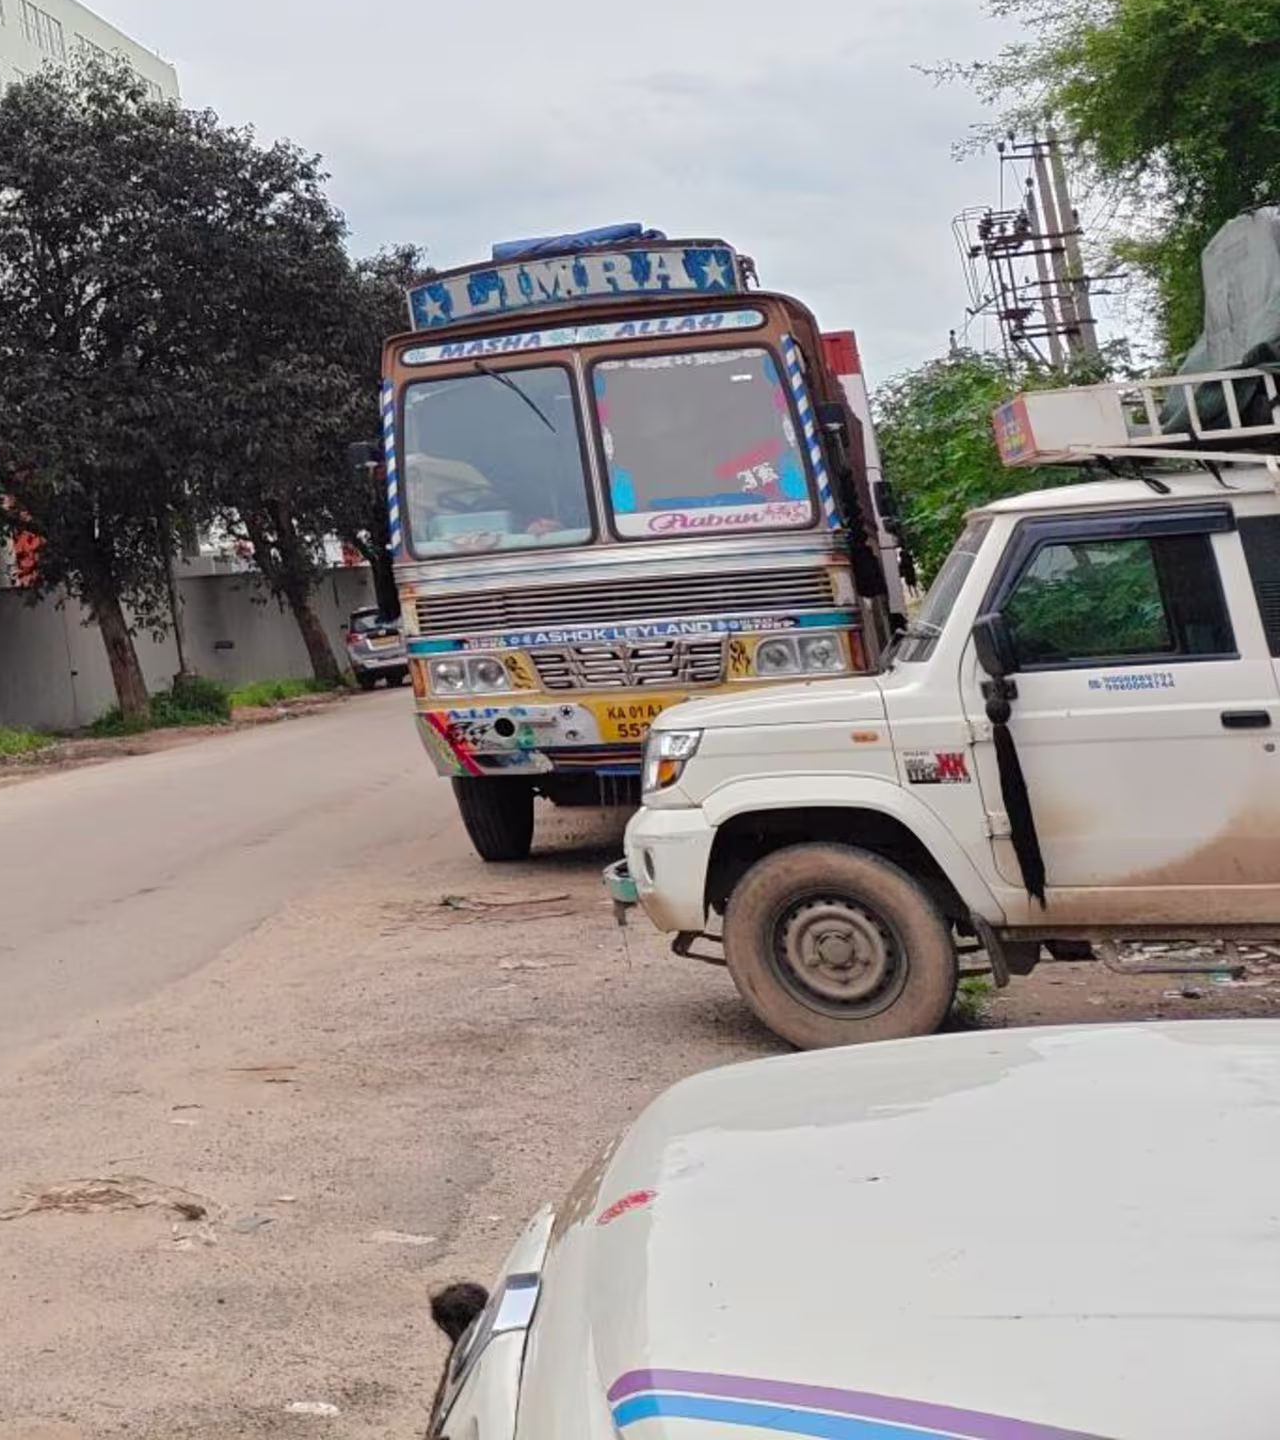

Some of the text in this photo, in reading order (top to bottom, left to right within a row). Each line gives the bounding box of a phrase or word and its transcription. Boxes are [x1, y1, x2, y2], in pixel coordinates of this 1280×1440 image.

[447, 252, 697, 317] LIMRA
[440, 314, 725, 359] MASHA ALLAH
[534, 621, 713, 645] ASHOK LEYLAND
[607, 706, 627, 720] KA
[629, 706, 644, 718] 01
